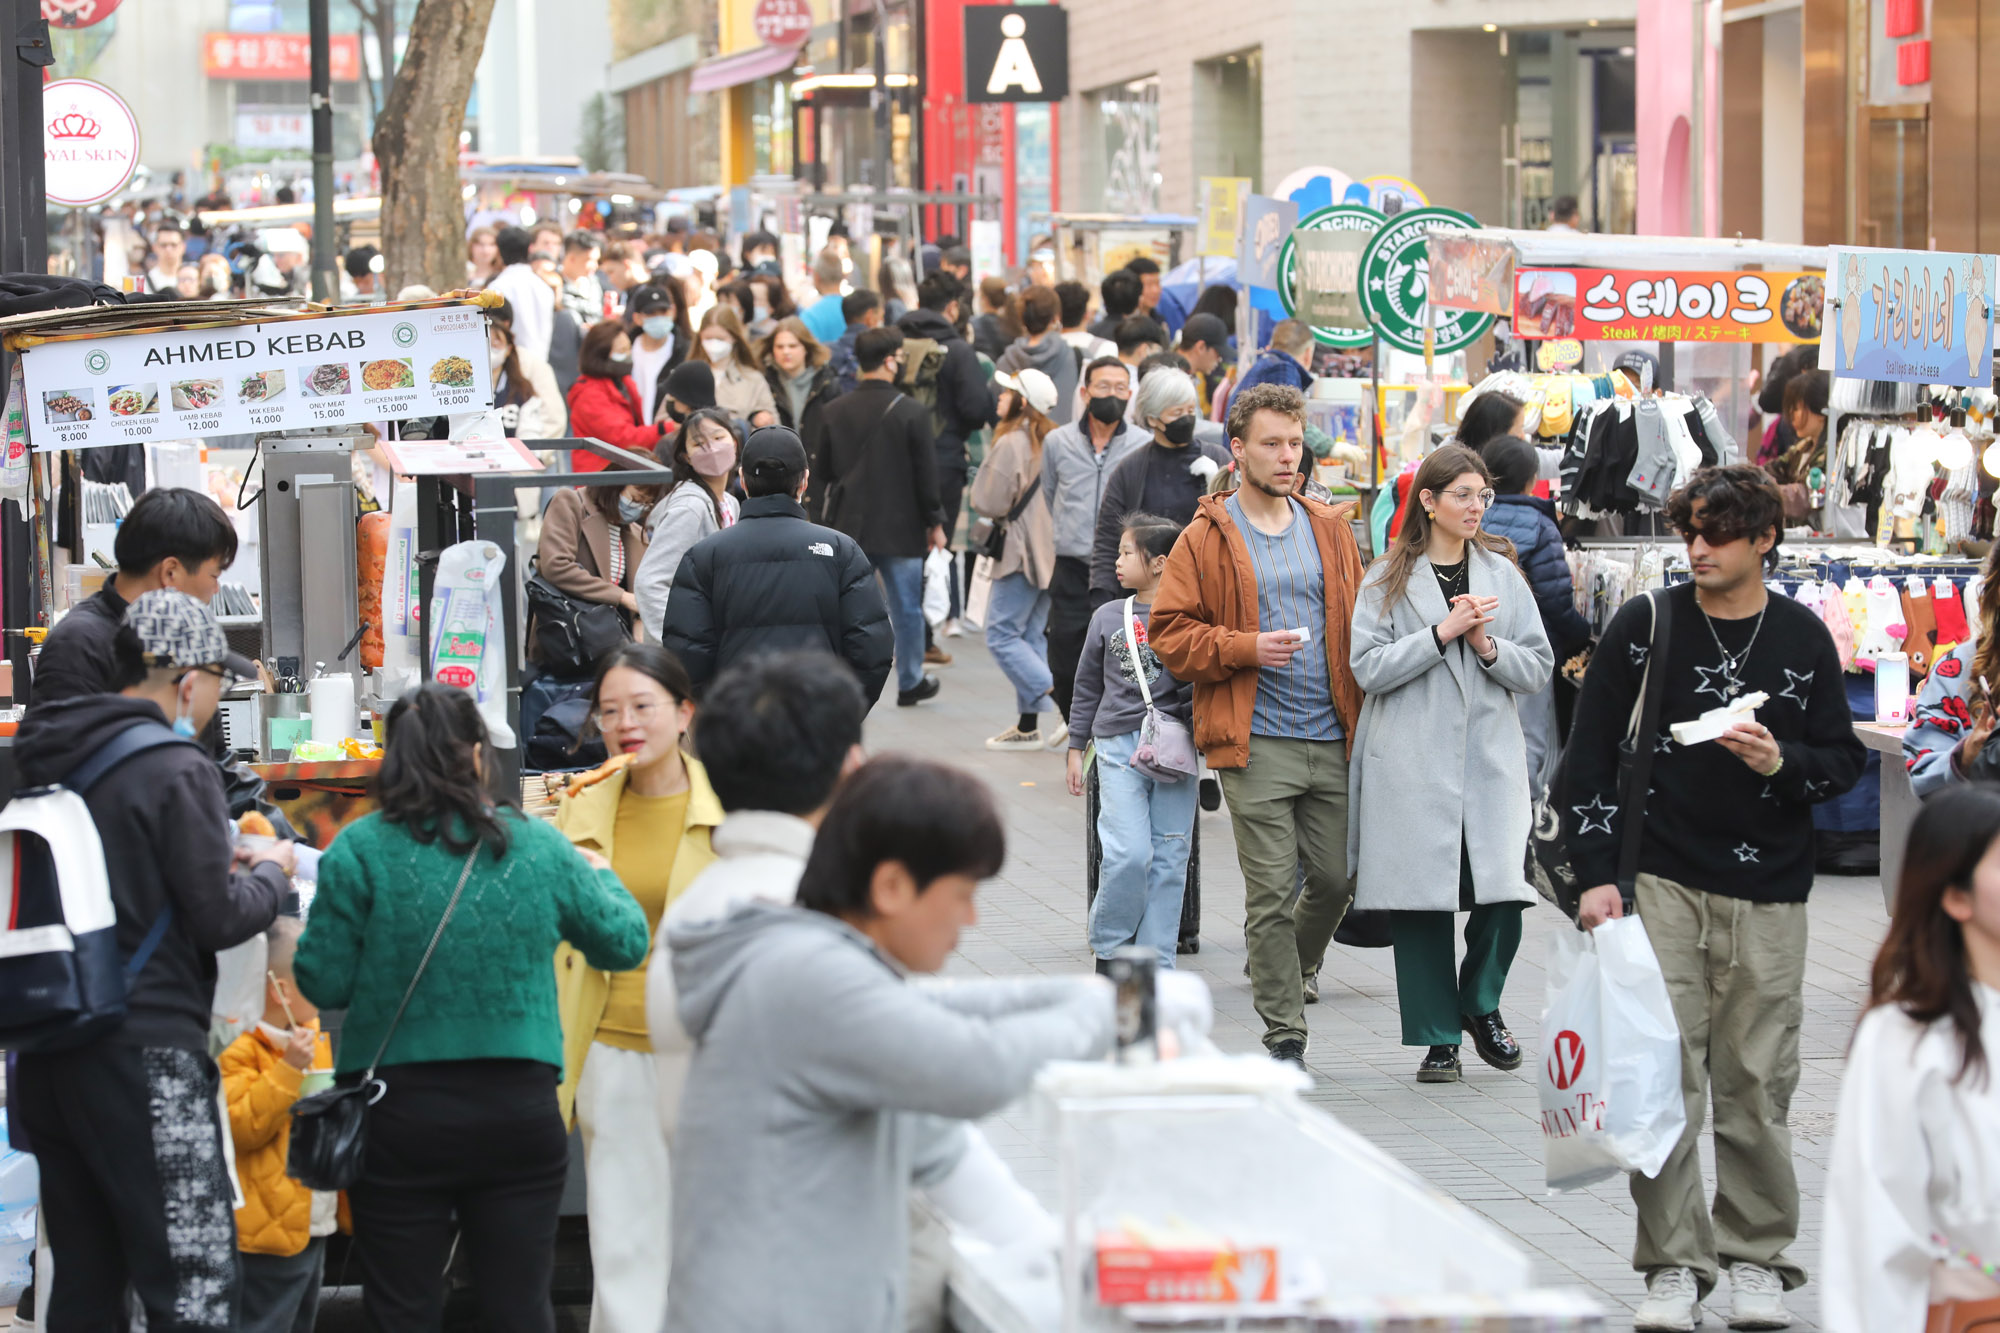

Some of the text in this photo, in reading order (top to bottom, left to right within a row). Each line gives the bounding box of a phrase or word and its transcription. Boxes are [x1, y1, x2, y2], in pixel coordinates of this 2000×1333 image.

[44, 149, 127, 161] YAL SKIN
[1582, 273, 1774, 324] 스테이크
[1872, 265, 1955, 352] 가리비네
[1602, 325, 1638, 340] Steak
[1695, 325, 1751, 340] ステーキ
[144, 339, 256, 367] AHMED
[267, 330, 366, 356] KEBAB
[1885, 360, 1940, 379] Scallops and cheese
[432, 387, 476, 398] LAMB BIRYANI
[364, 393, 418, 405] CHICKEN BIRYANI
[438, 395, 470, 406] 18.000
[309, 400, 346, 410] ONLY MEAT
[377, 402, 408, 413] 15.000
[179, 411, 223, 422] LAMB KEBAB
[314, 408, 345, 419] 15.000
[111, 417, 159, 428] CHICKEN KEBAB
[250, 414, 282, 425] 14.000
[52, 423, 90, 433] LAMB STICK
[188, 420, 219, 431] 12.000
[61, 432, 88, 442] 8.000
[124, 426, 152, 437] 10.000
